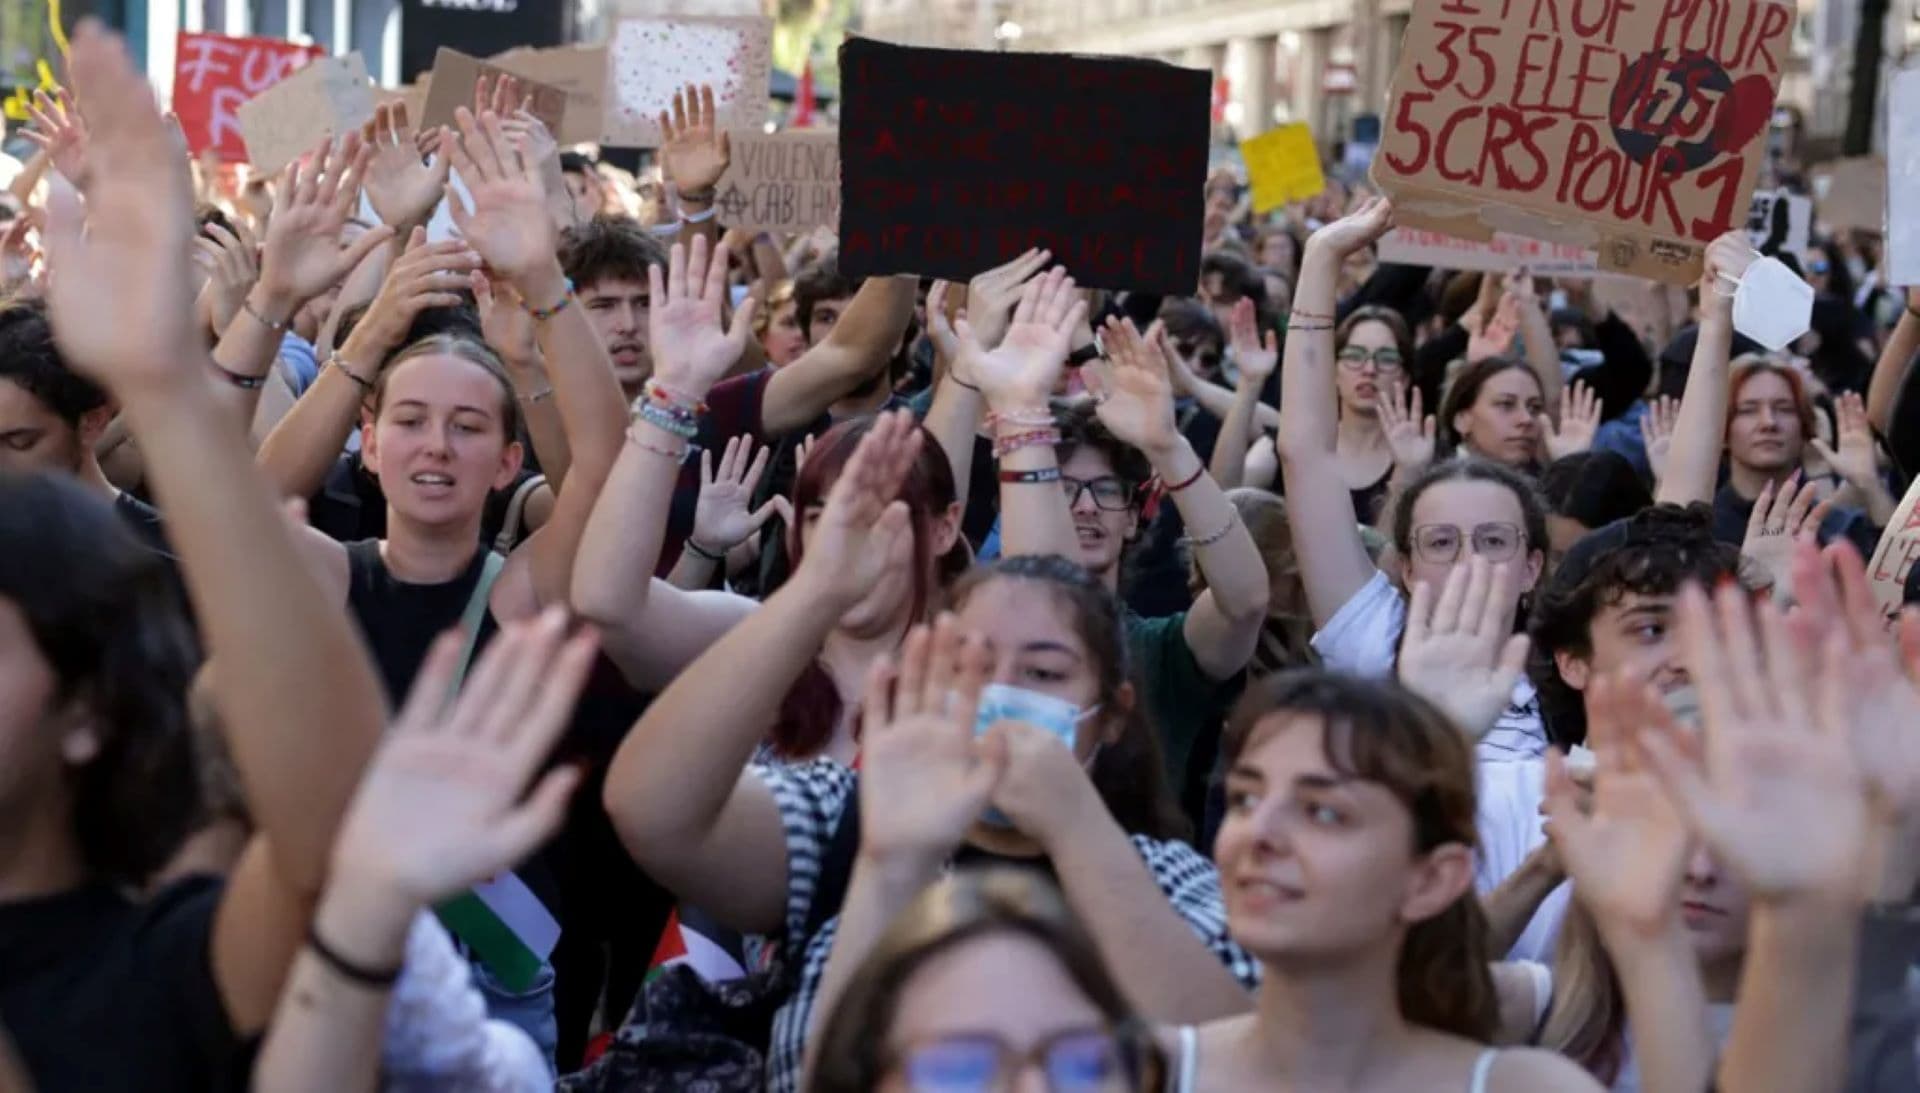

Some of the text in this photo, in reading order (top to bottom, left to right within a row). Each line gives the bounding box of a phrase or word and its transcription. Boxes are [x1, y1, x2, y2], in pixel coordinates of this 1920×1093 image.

[1416, 21, 1712, 137] 35 ELEVES
[1653, 0, 1788, 73] POUR
[1556, 122, 1686, 237] POUR
[1691, 157, 1745, 242] 1
